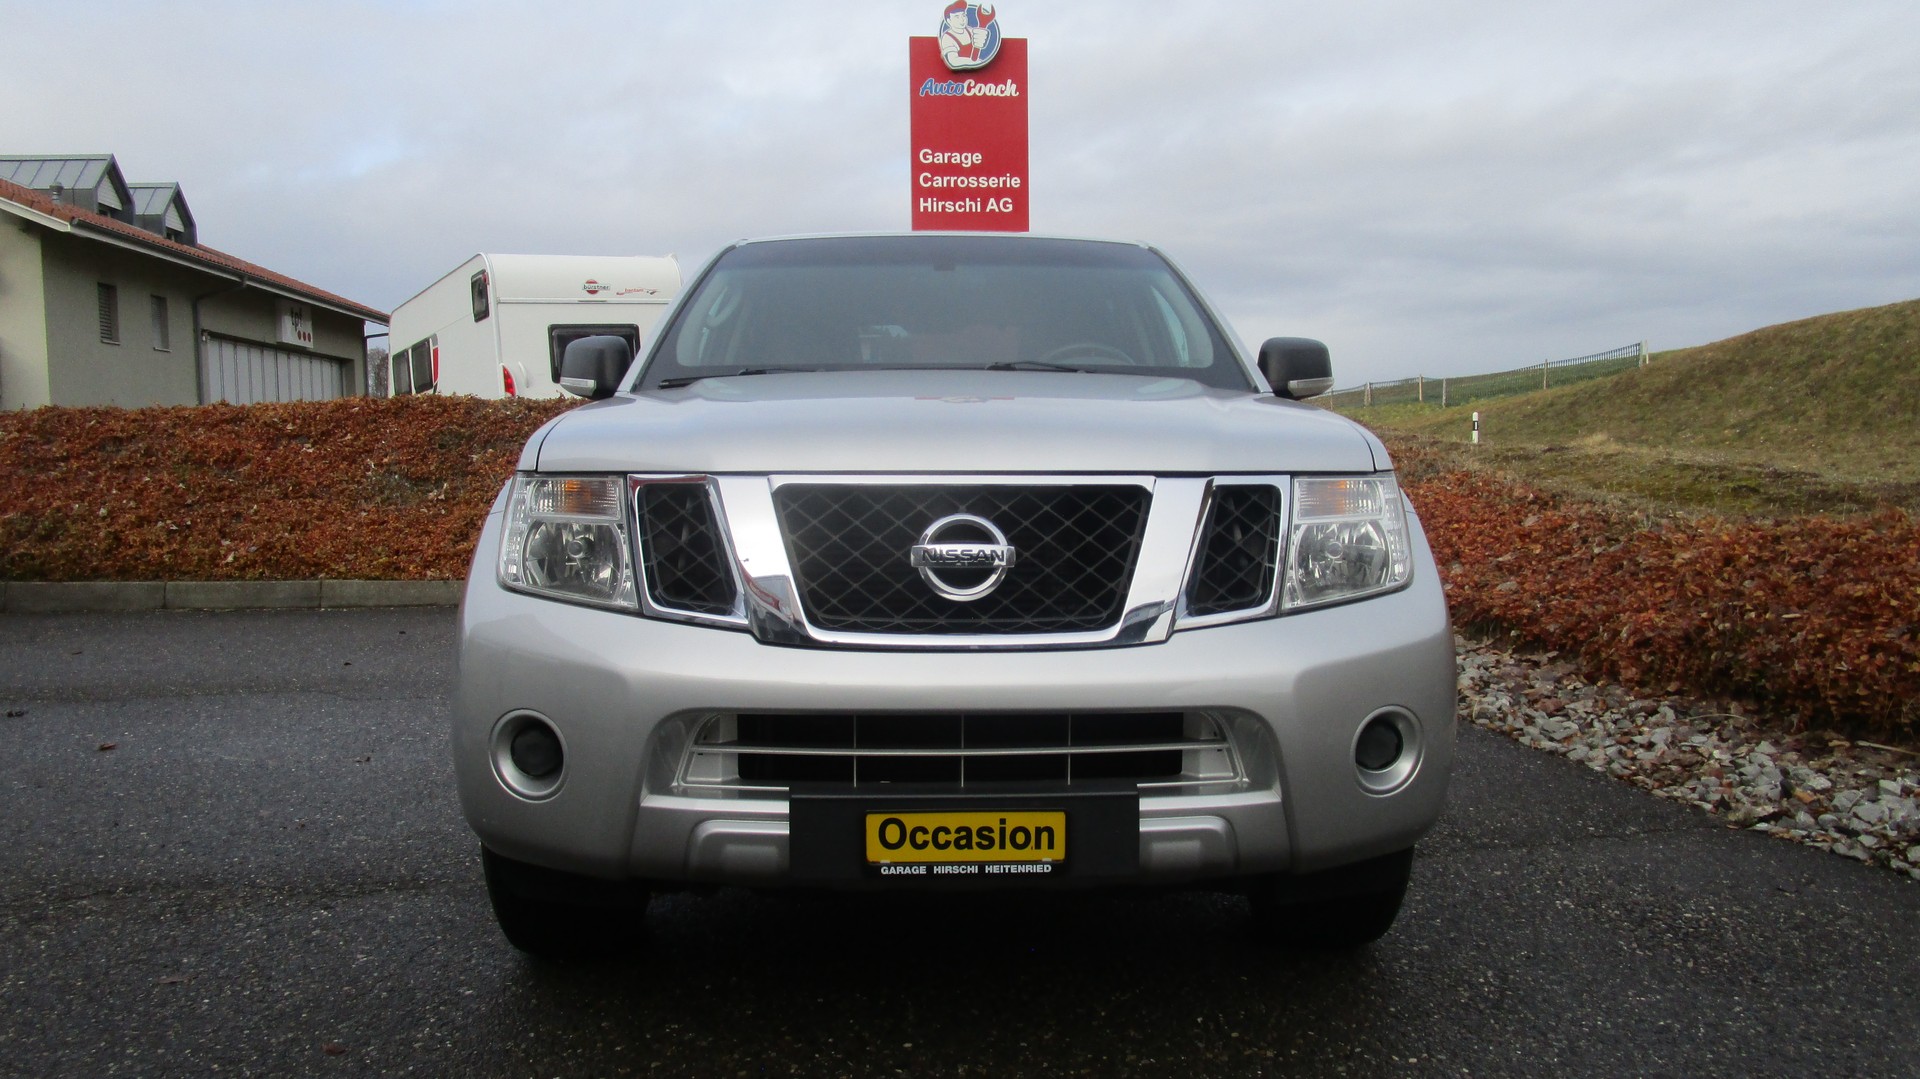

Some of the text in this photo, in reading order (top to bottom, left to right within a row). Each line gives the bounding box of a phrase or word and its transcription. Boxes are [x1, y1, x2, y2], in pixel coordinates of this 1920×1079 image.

[920, 78, 1019, 97] AutoCoach
[919, 149, 982, 167] Garage
[919, 172, 1021, 188] Carrosserie
[919, 197, 1013, 213] Hirschi AG
[583, 283, 610, 291] bürstner
[922, 549, 1005, 563] NISSAN
[878, 817, 1055, 851] Occasion
[880, 863, 1052, 875] GARAGE HIRSCHI HEITENRIED
